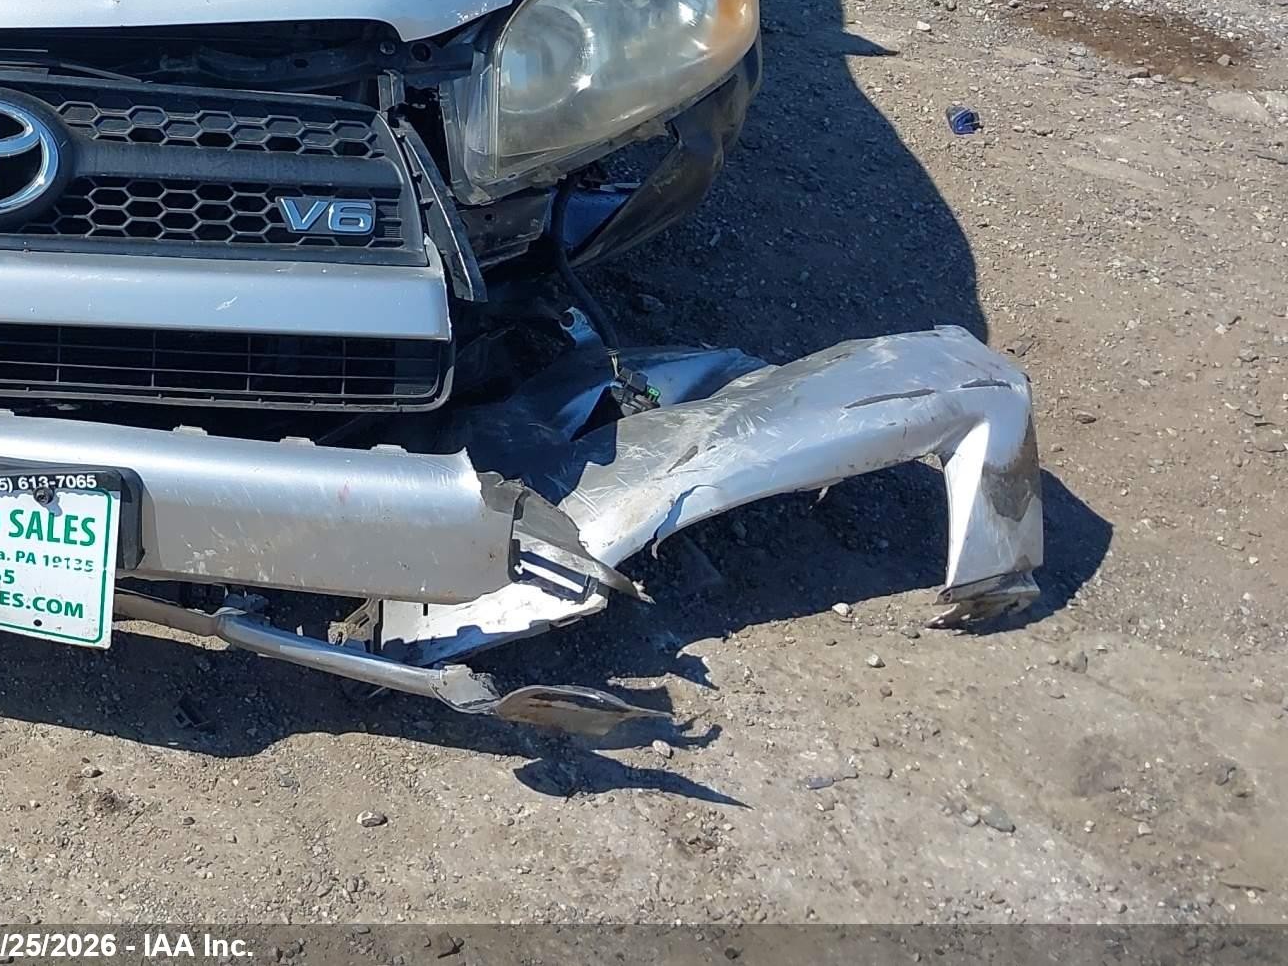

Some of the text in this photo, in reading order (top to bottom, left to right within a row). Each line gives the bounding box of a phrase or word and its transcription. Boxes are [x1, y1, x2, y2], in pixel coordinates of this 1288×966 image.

[280, 198, 372, 232] V6
[18, 475, 97, 489] 613-7065
[8, 509, 96, 547] SALES
[16, 550, 37, 565] PA
